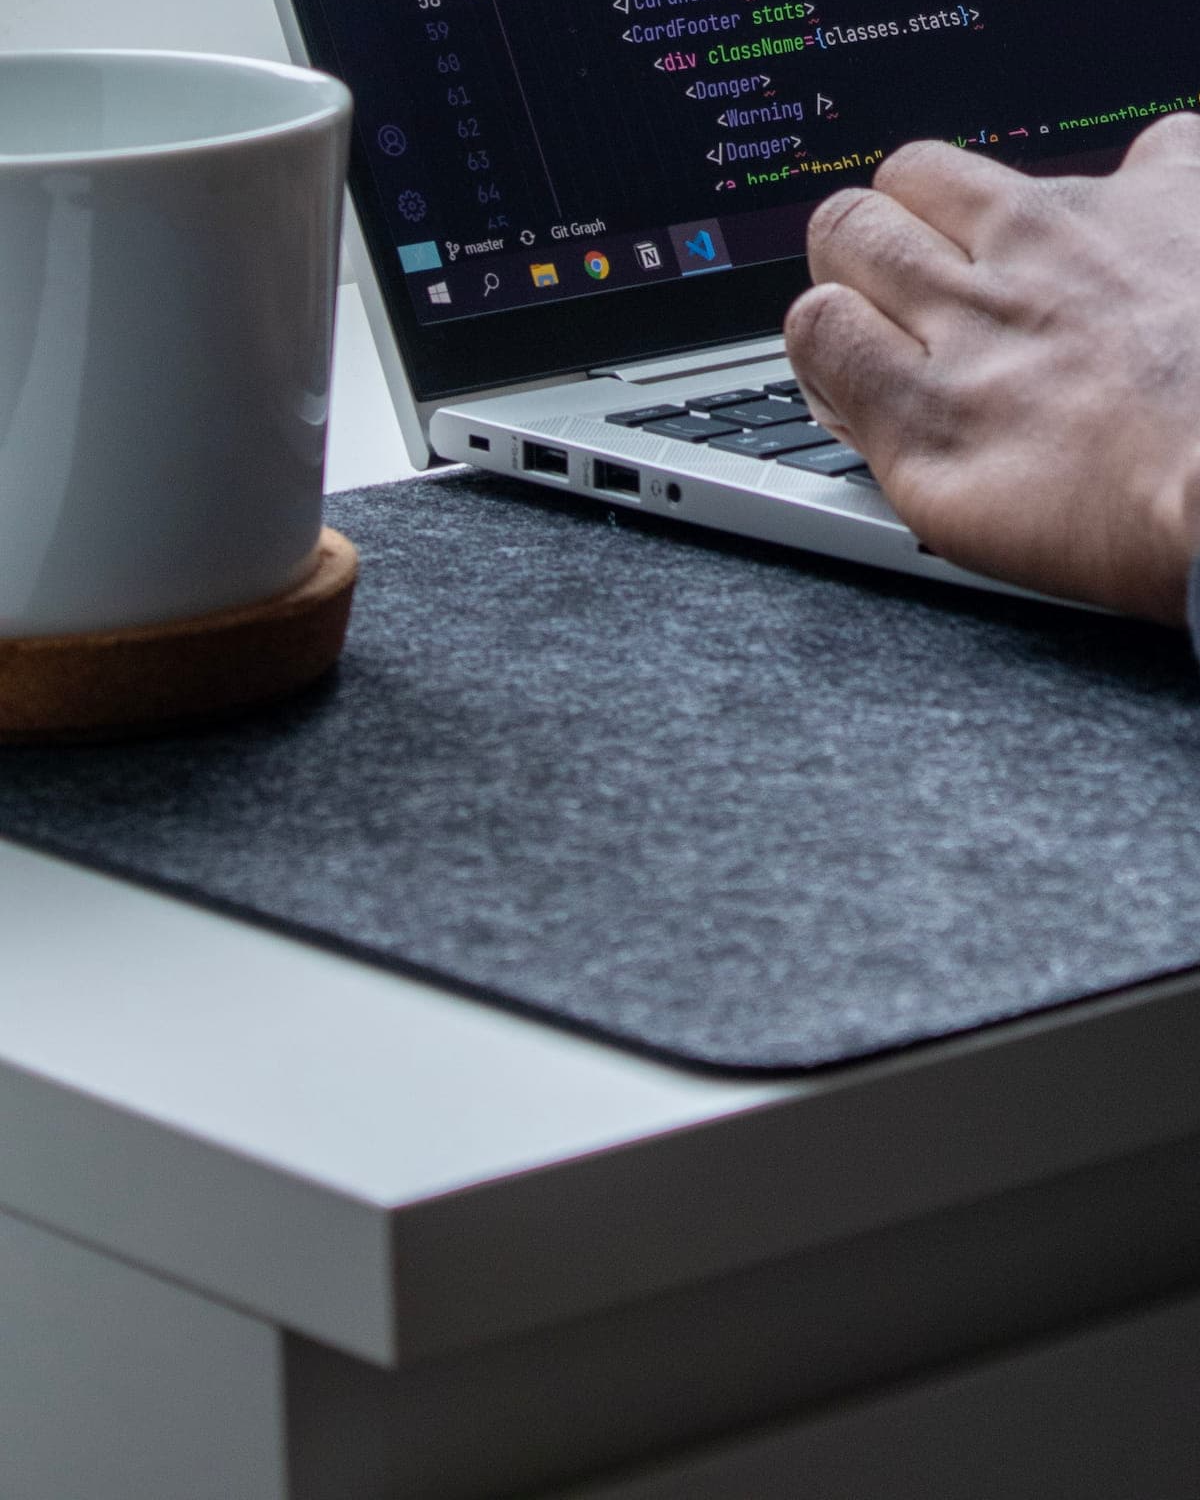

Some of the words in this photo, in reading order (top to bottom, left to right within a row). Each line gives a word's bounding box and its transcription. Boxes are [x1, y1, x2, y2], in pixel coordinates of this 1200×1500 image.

[426, 21, 448, 41] 59
[622, 13, 740, 45] <CardFooter
[752, 2, 815, 25] stats>
[654, 52, 697, 72] <div
[708, 5, 980, 65] className={classes.stats}>
[437, 53, 461, 74] 60
[448, 86, 471, 106] 61
[685, 74, 771, 101] <Danger>
[717, 101, 804, 128] <Warning
[457, 117, 480, 139] 62
[467, 150, 490, 171] 63
[706, 135, 801, 165] </Danger>
[477, 182, 501, 204] 64
[551, 223, 569, 240] Git
[570, 218, 606, 237] Graph
[465, 238, 505, 255] master
